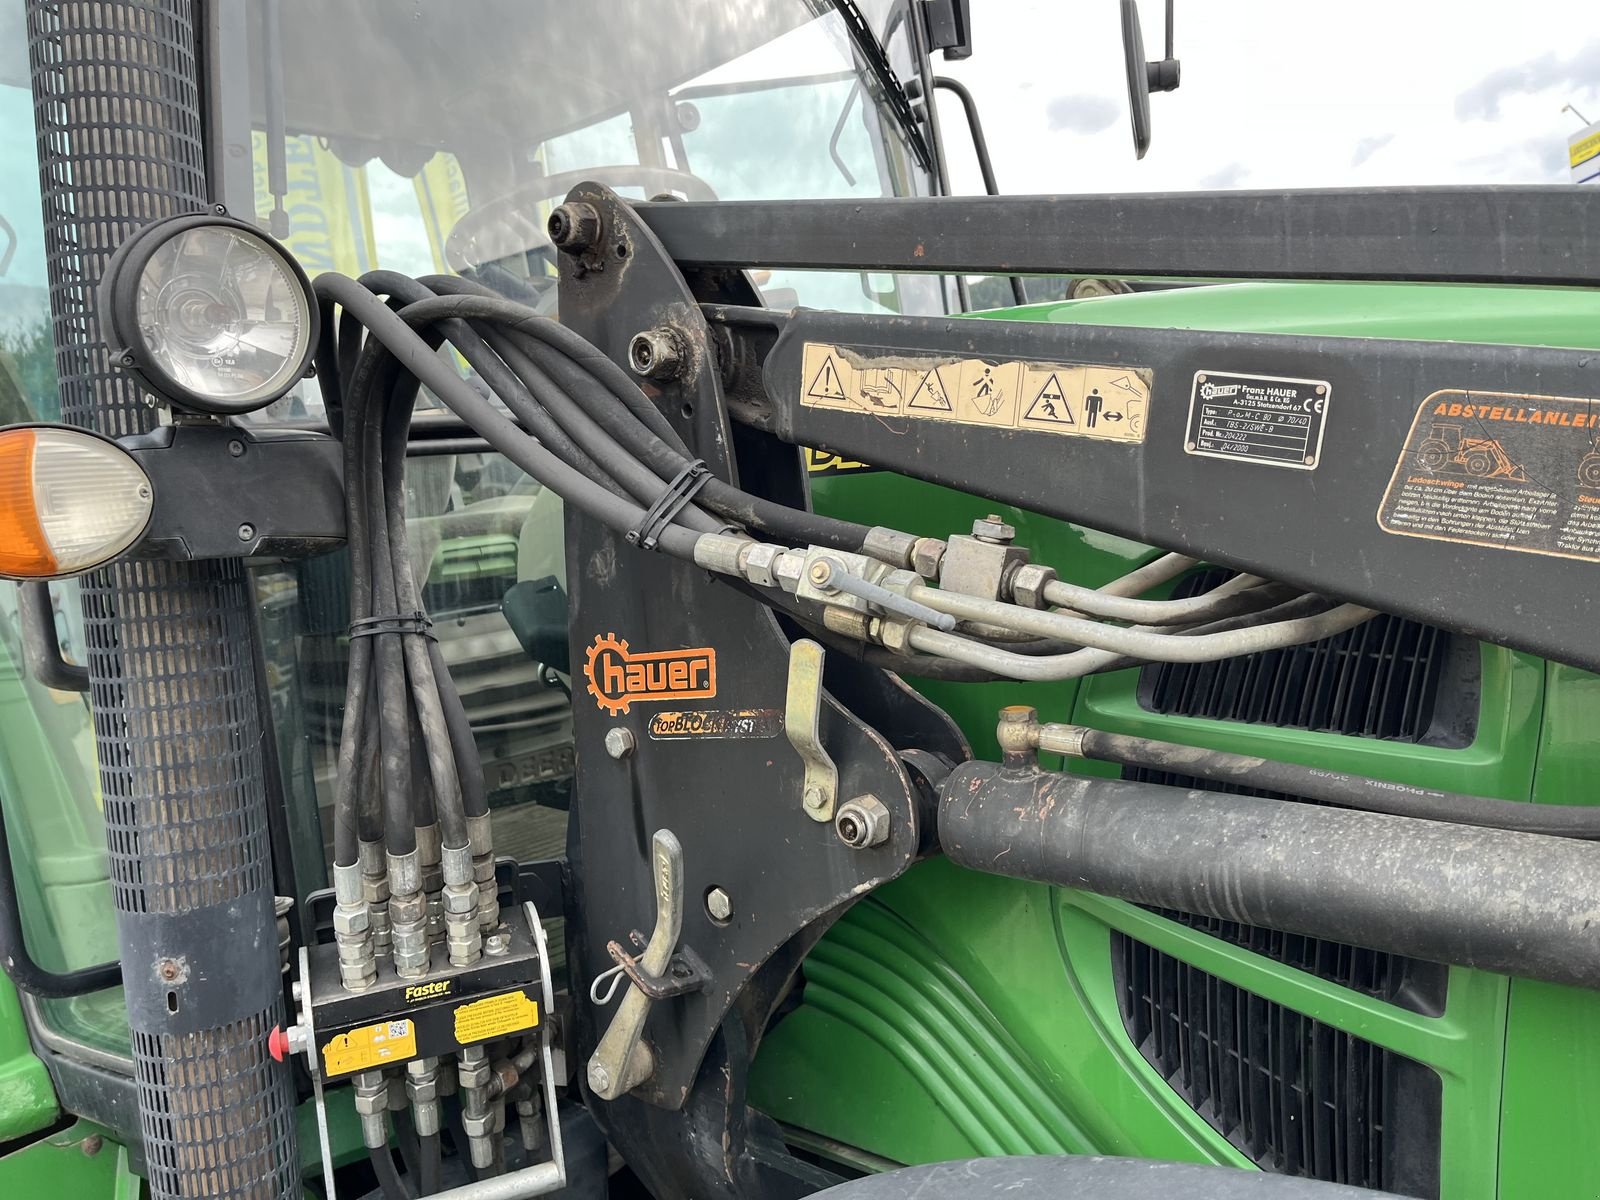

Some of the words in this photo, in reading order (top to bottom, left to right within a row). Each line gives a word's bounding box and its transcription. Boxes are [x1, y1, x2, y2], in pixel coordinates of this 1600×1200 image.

[1241, 385, 1265, 396] Franz
[1266, 386, 1297, 398] HAUER
[1233, 399, 1256, 407] A-3125
[1303, 399, 1323, 413] CE
[1287, 416, 1308, 425] 70/40
[1434, 402, 1600, 428] ABSTELLANLEI
[603, 653, 708, 693] hauer
[405, 979, 450, 1000] Faster
